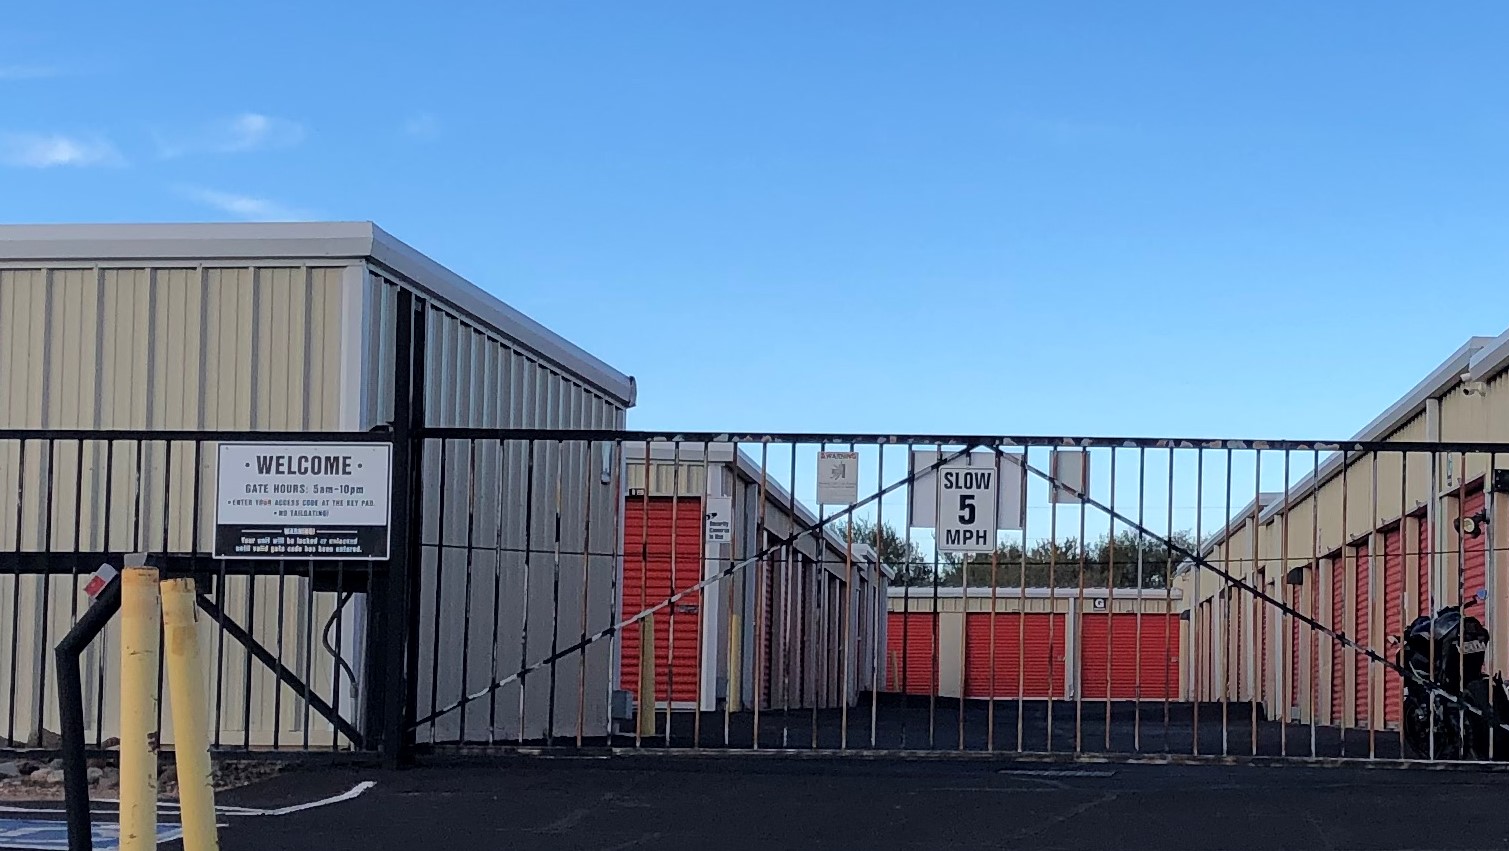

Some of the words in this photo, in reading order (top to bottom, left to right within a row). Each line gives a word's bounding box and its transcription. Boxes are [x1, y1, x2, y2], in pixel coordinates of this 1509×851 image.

[256, 455, 352, 476] WELCOME
[245, 483, 269, 494] GATE
[273, 484, 309, 494] HOURS:
[312, 484, 364, 495] 5am-10pm
[943, 471, 992, 490] SLOW
[958, 494, 976, 525] 5
[946, 529, 987, 545] MPH
